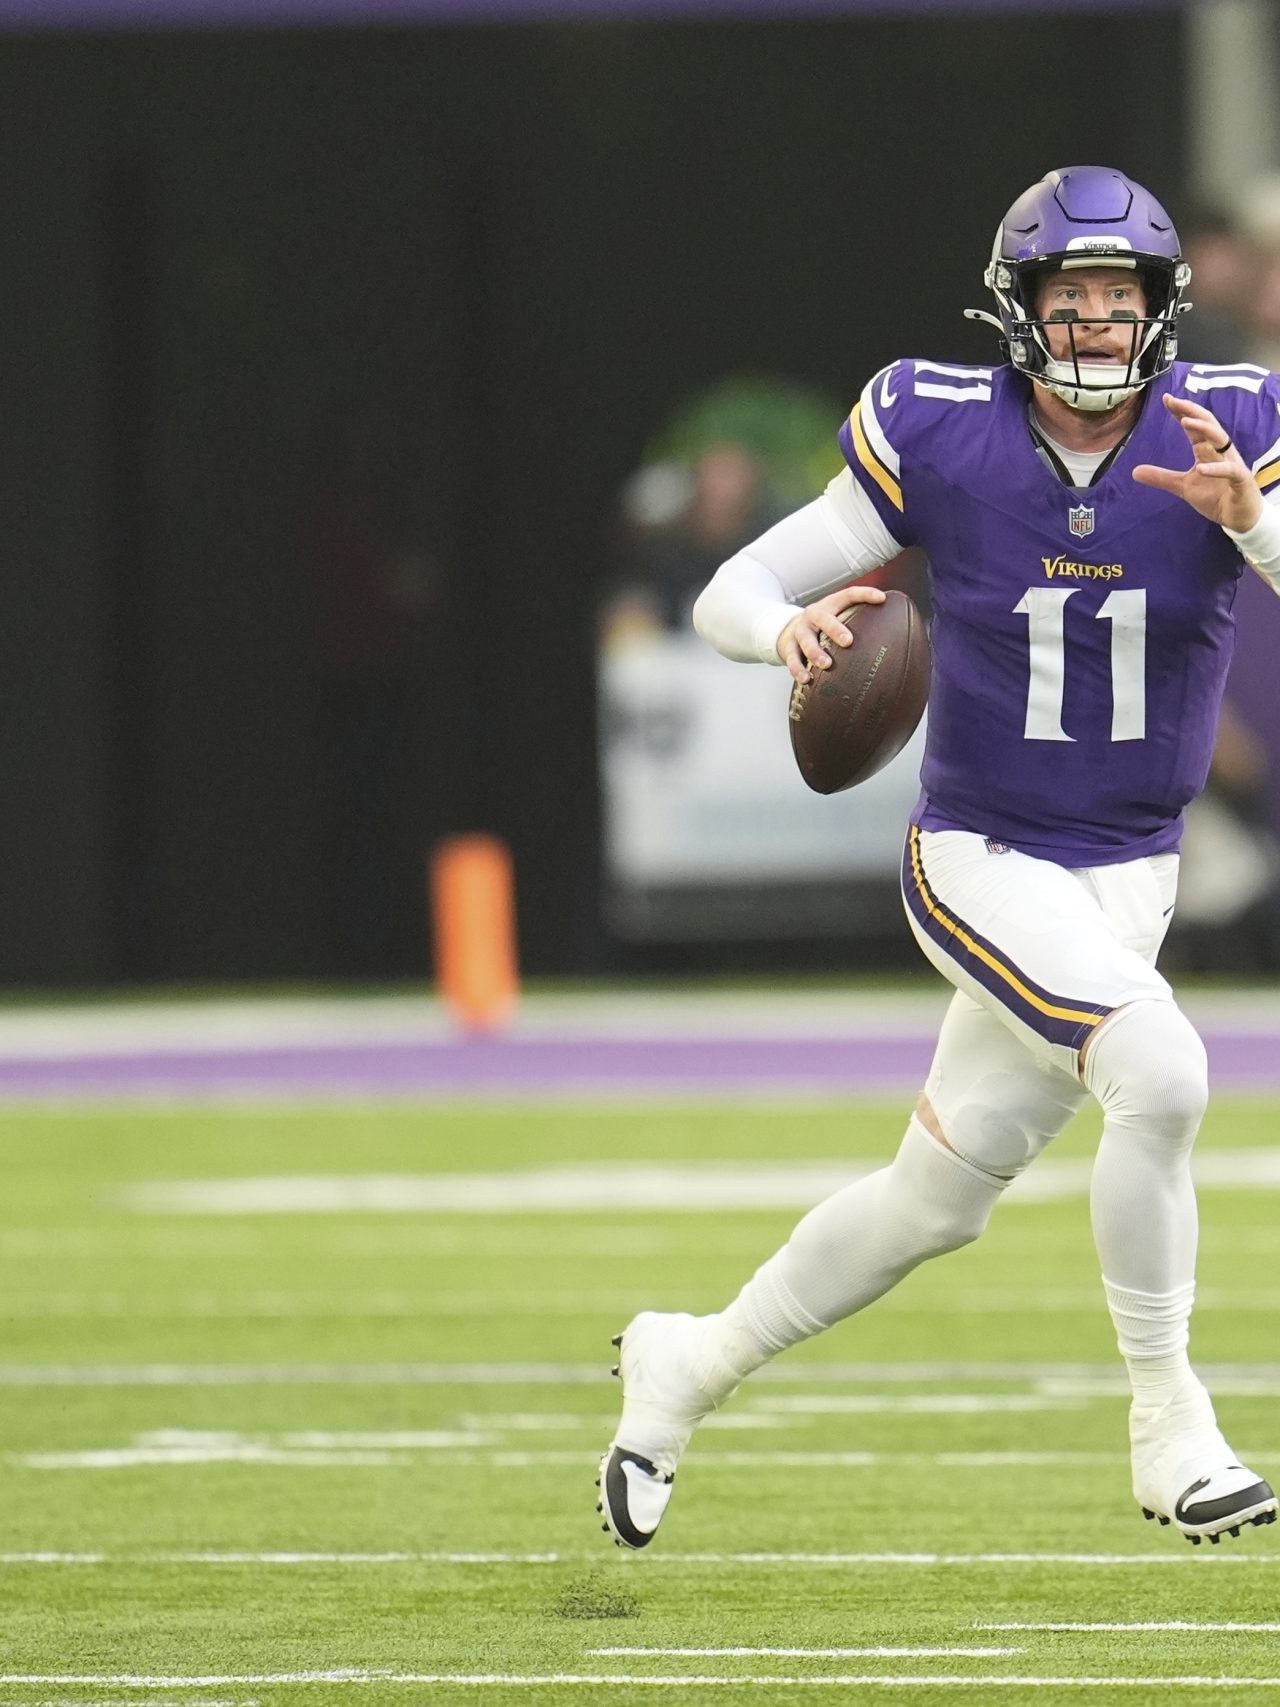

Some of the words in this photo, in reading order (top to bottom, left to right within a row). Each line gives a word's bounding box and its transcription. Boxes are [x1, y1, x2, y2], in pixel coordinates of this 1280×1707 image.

[914, 361, 993, 402] 11
[1185, 363, 1271, 394] 11
[1073, 520, 1091, 531] NFL
[868, 644, 888, 678] LEAGUE
[1012, 587, 1147, 742] 11
